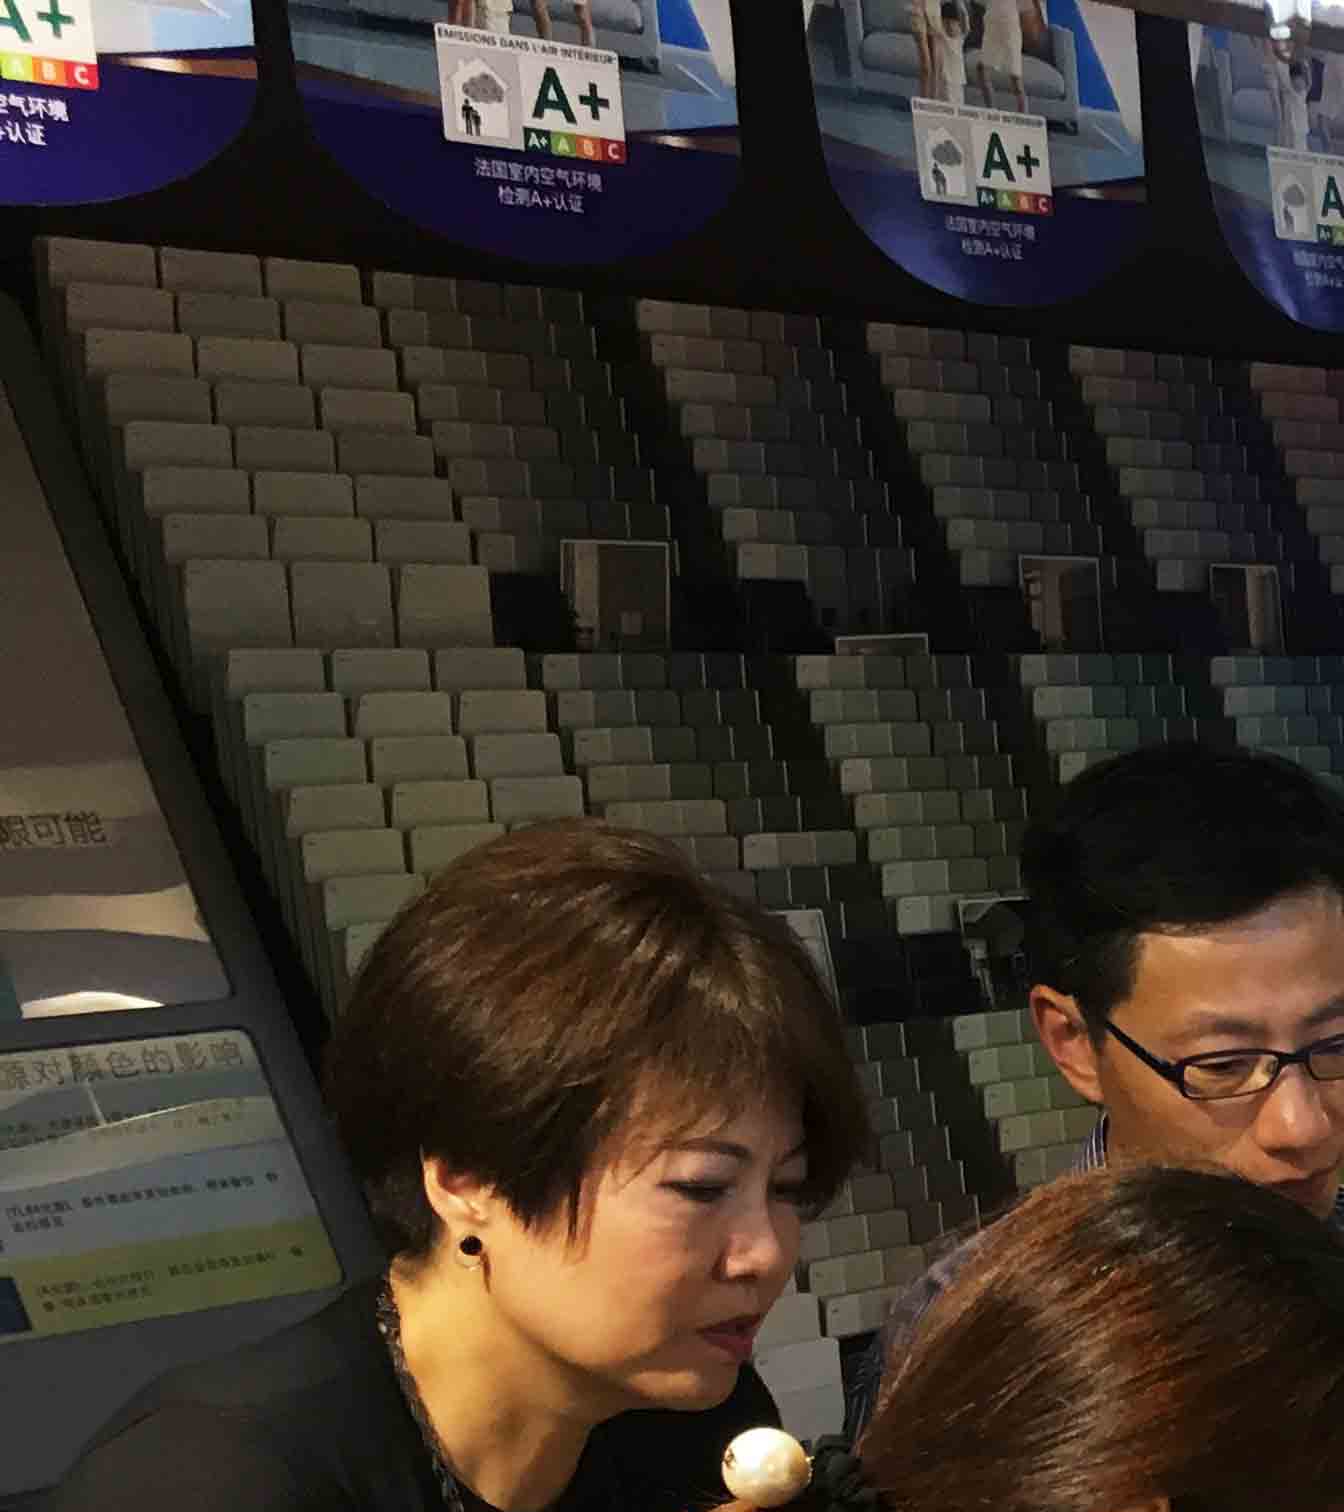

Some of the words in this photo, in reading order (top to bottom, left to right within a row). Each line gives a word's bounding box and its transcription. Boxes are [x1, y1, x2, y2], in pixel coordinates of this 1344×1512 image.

[74, 64, 90, 85] C
[532, 66, 609, 125] A+
[528, 132, 549, 149] A+
[607, 143, 620, 159] C
[982, 131, 1040, 183] A+
[474, 157, 603, 193] 法国室内空气环境
[497, 184, 584, 214] 检测A+认证
